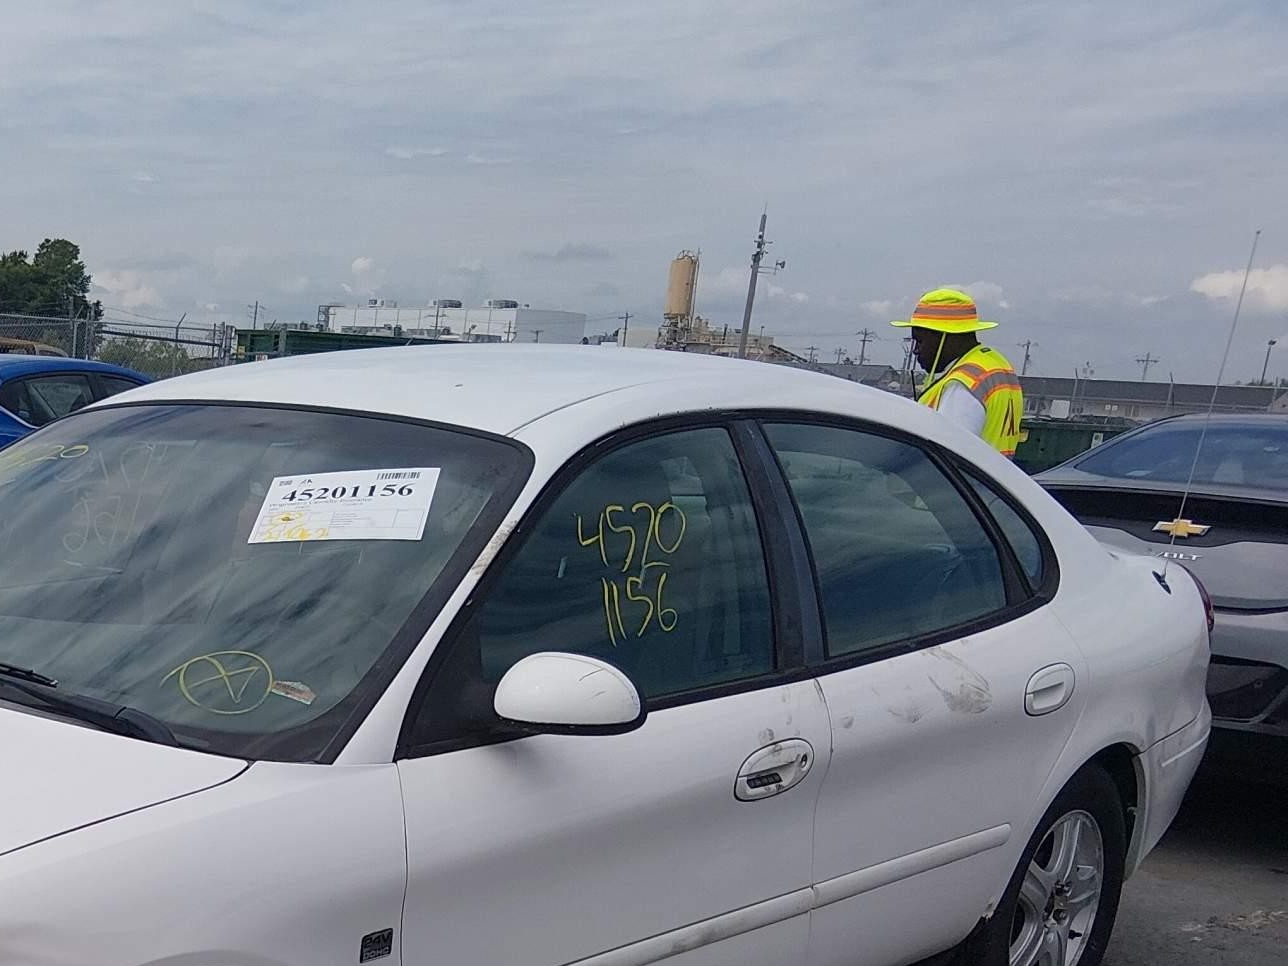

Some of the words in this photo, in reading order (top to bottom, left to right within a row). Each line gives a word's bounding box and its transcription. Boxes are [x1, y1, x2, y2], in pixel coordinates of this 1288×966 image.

[282, 482, 416, 502] 45201156
[577, 502, 686, 576] 4520
[601, 572, 678, 647] 1156
